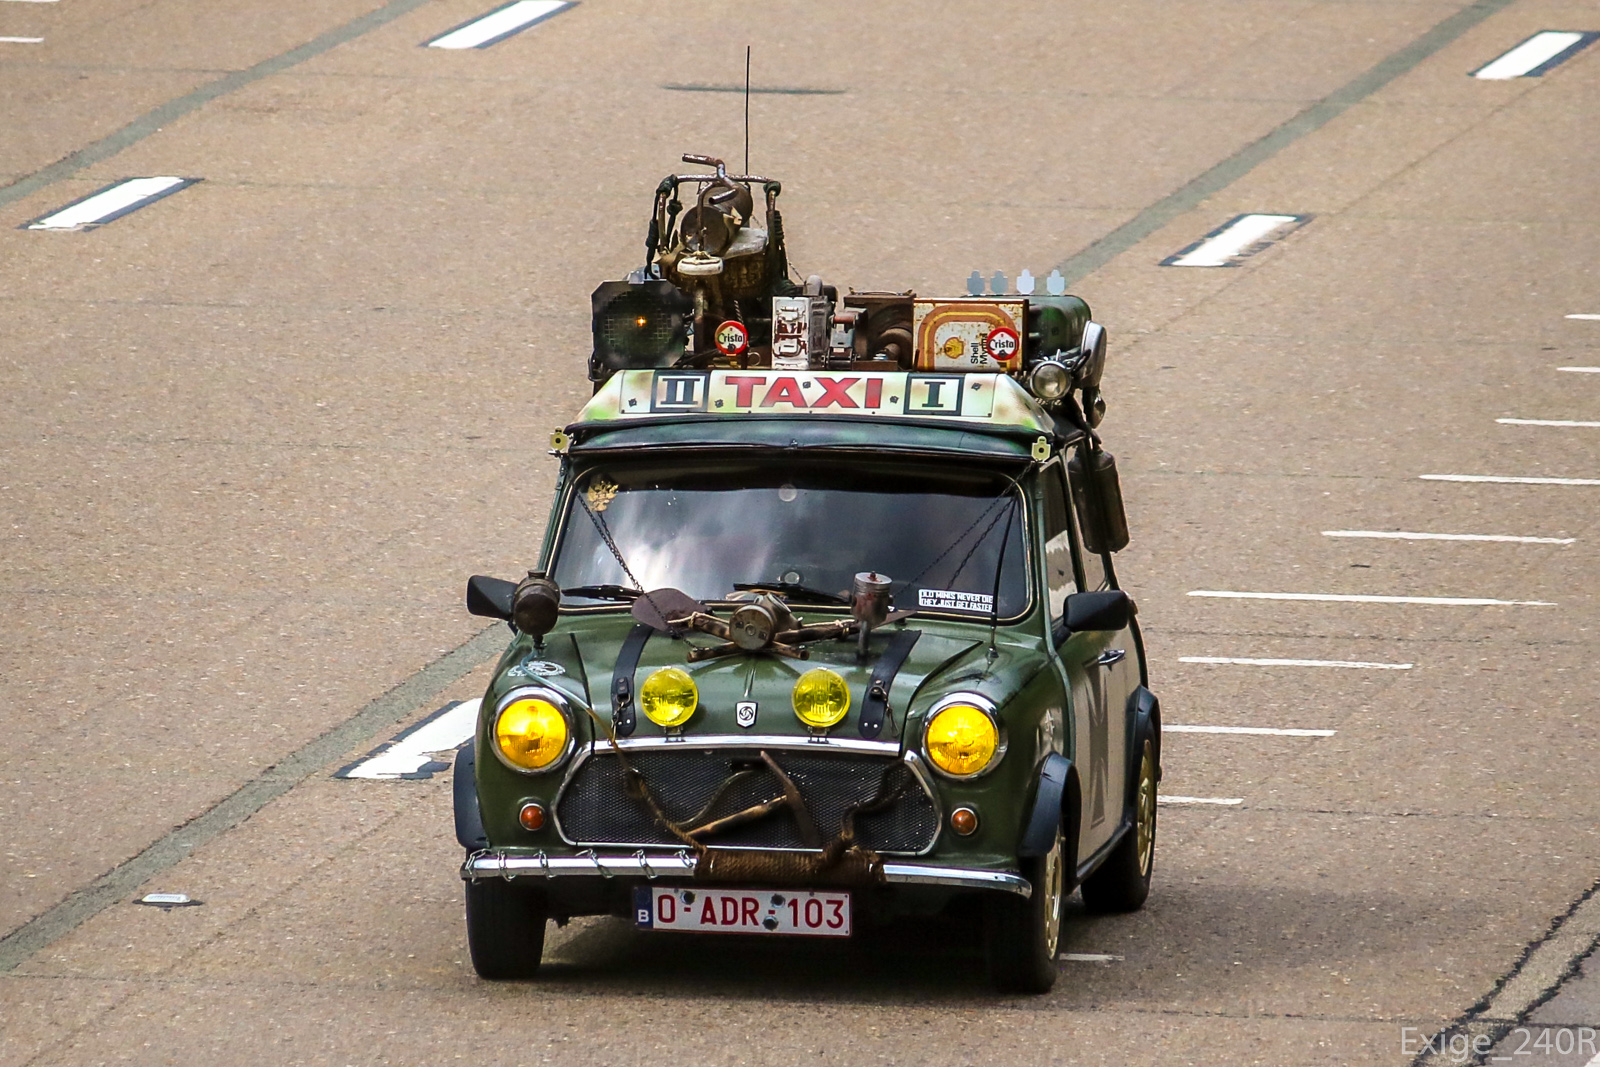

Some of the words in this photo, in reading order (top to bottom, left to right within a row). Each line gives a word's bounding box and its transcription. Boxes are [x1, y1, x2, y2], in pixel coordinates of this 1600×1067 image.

[970, 343, 979, 364] Shell
[725, 376, 884, 409] TAXI
[921, 598, 937, 606] THEY
[938, 599, 955, 607] JUST
[935, 592, 955, 600] MINIS
[957, 594, 981, 602] NEVER
[637, 909, 650, 923] B
